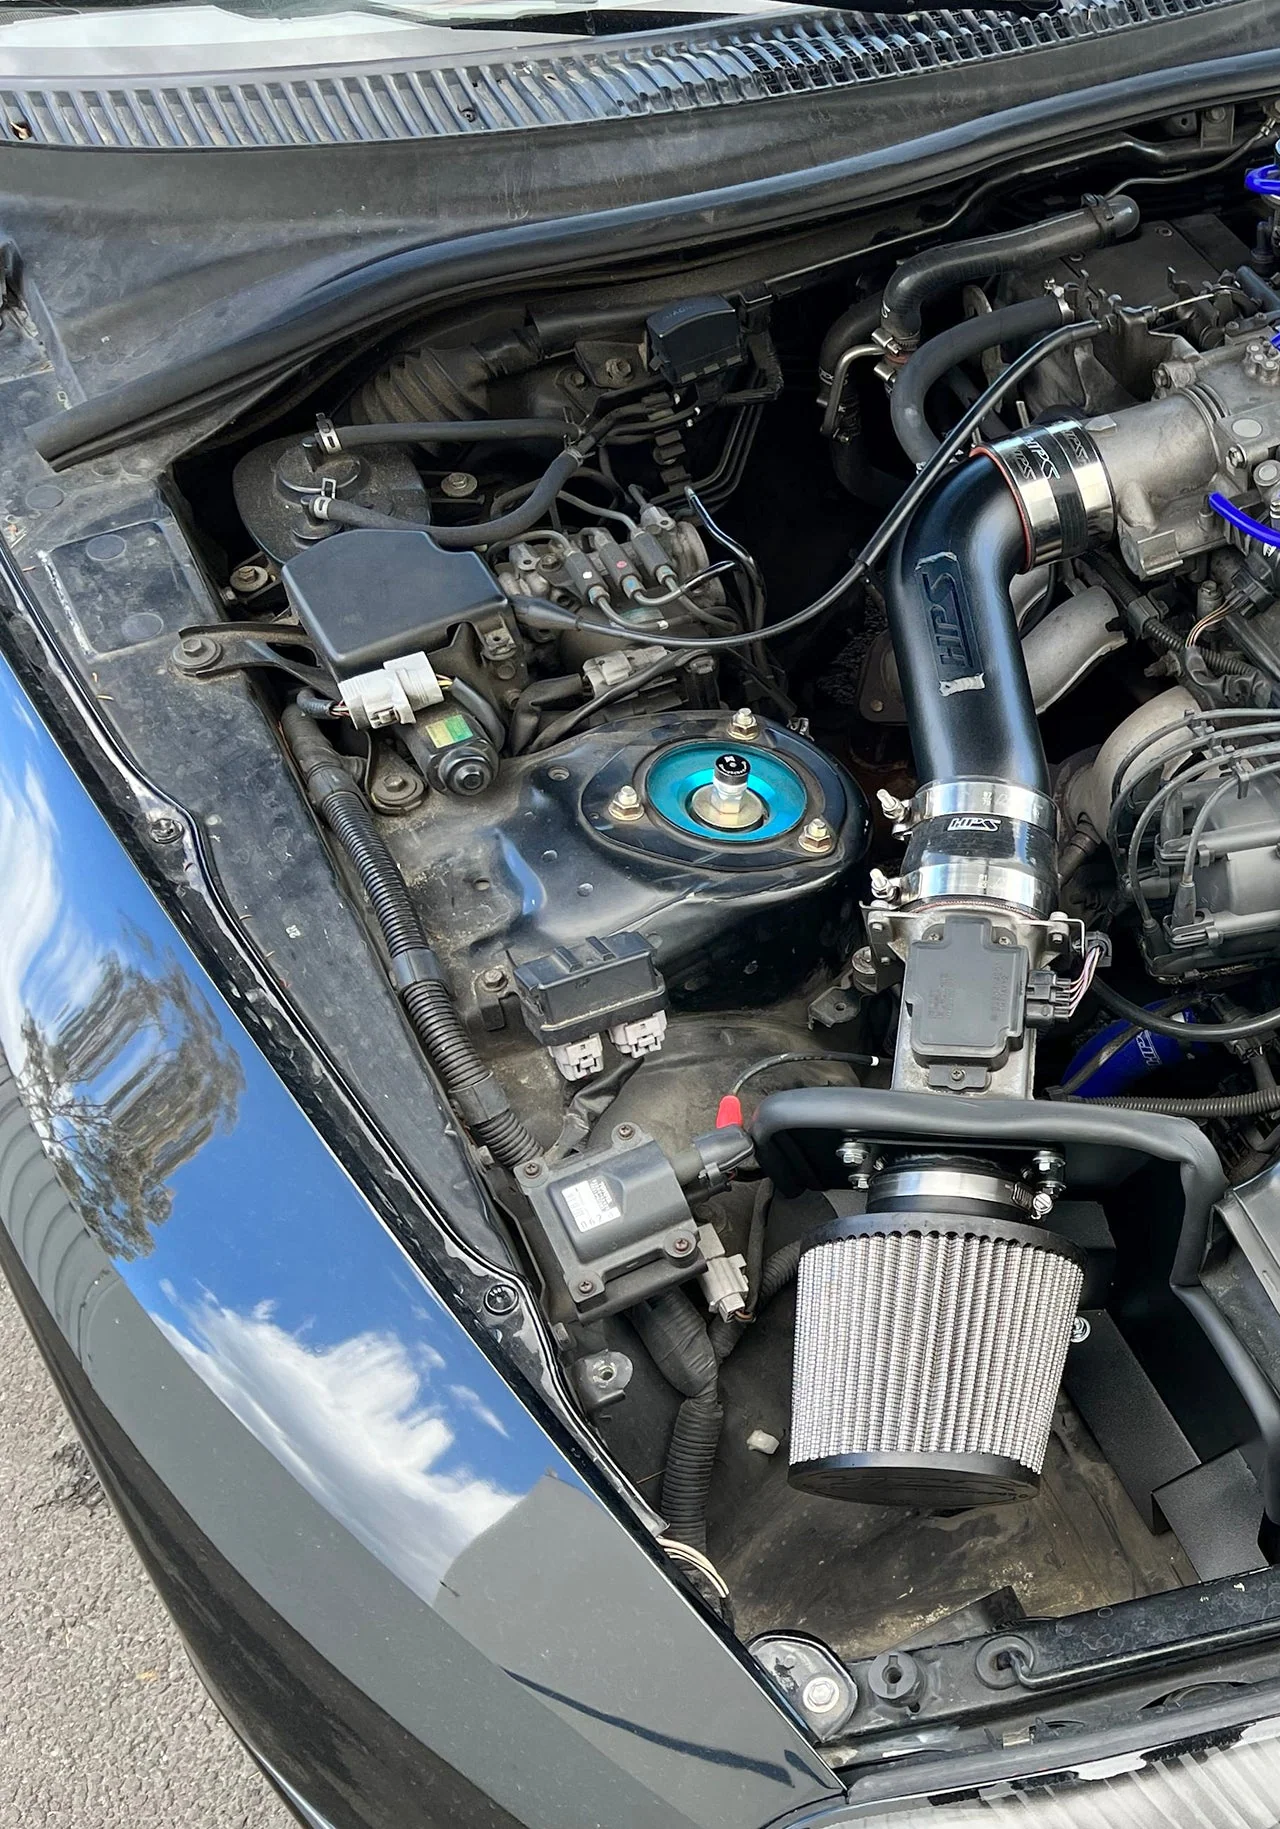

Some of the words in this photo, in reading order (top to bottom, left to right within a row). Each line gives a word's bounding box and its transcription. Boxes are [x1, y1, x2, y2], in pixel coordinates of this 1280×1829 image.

[1022, 435, 1061, 480] HPS
[921, 571, 975, 669] HPS
[947, 817, 1003, 832] HPS
